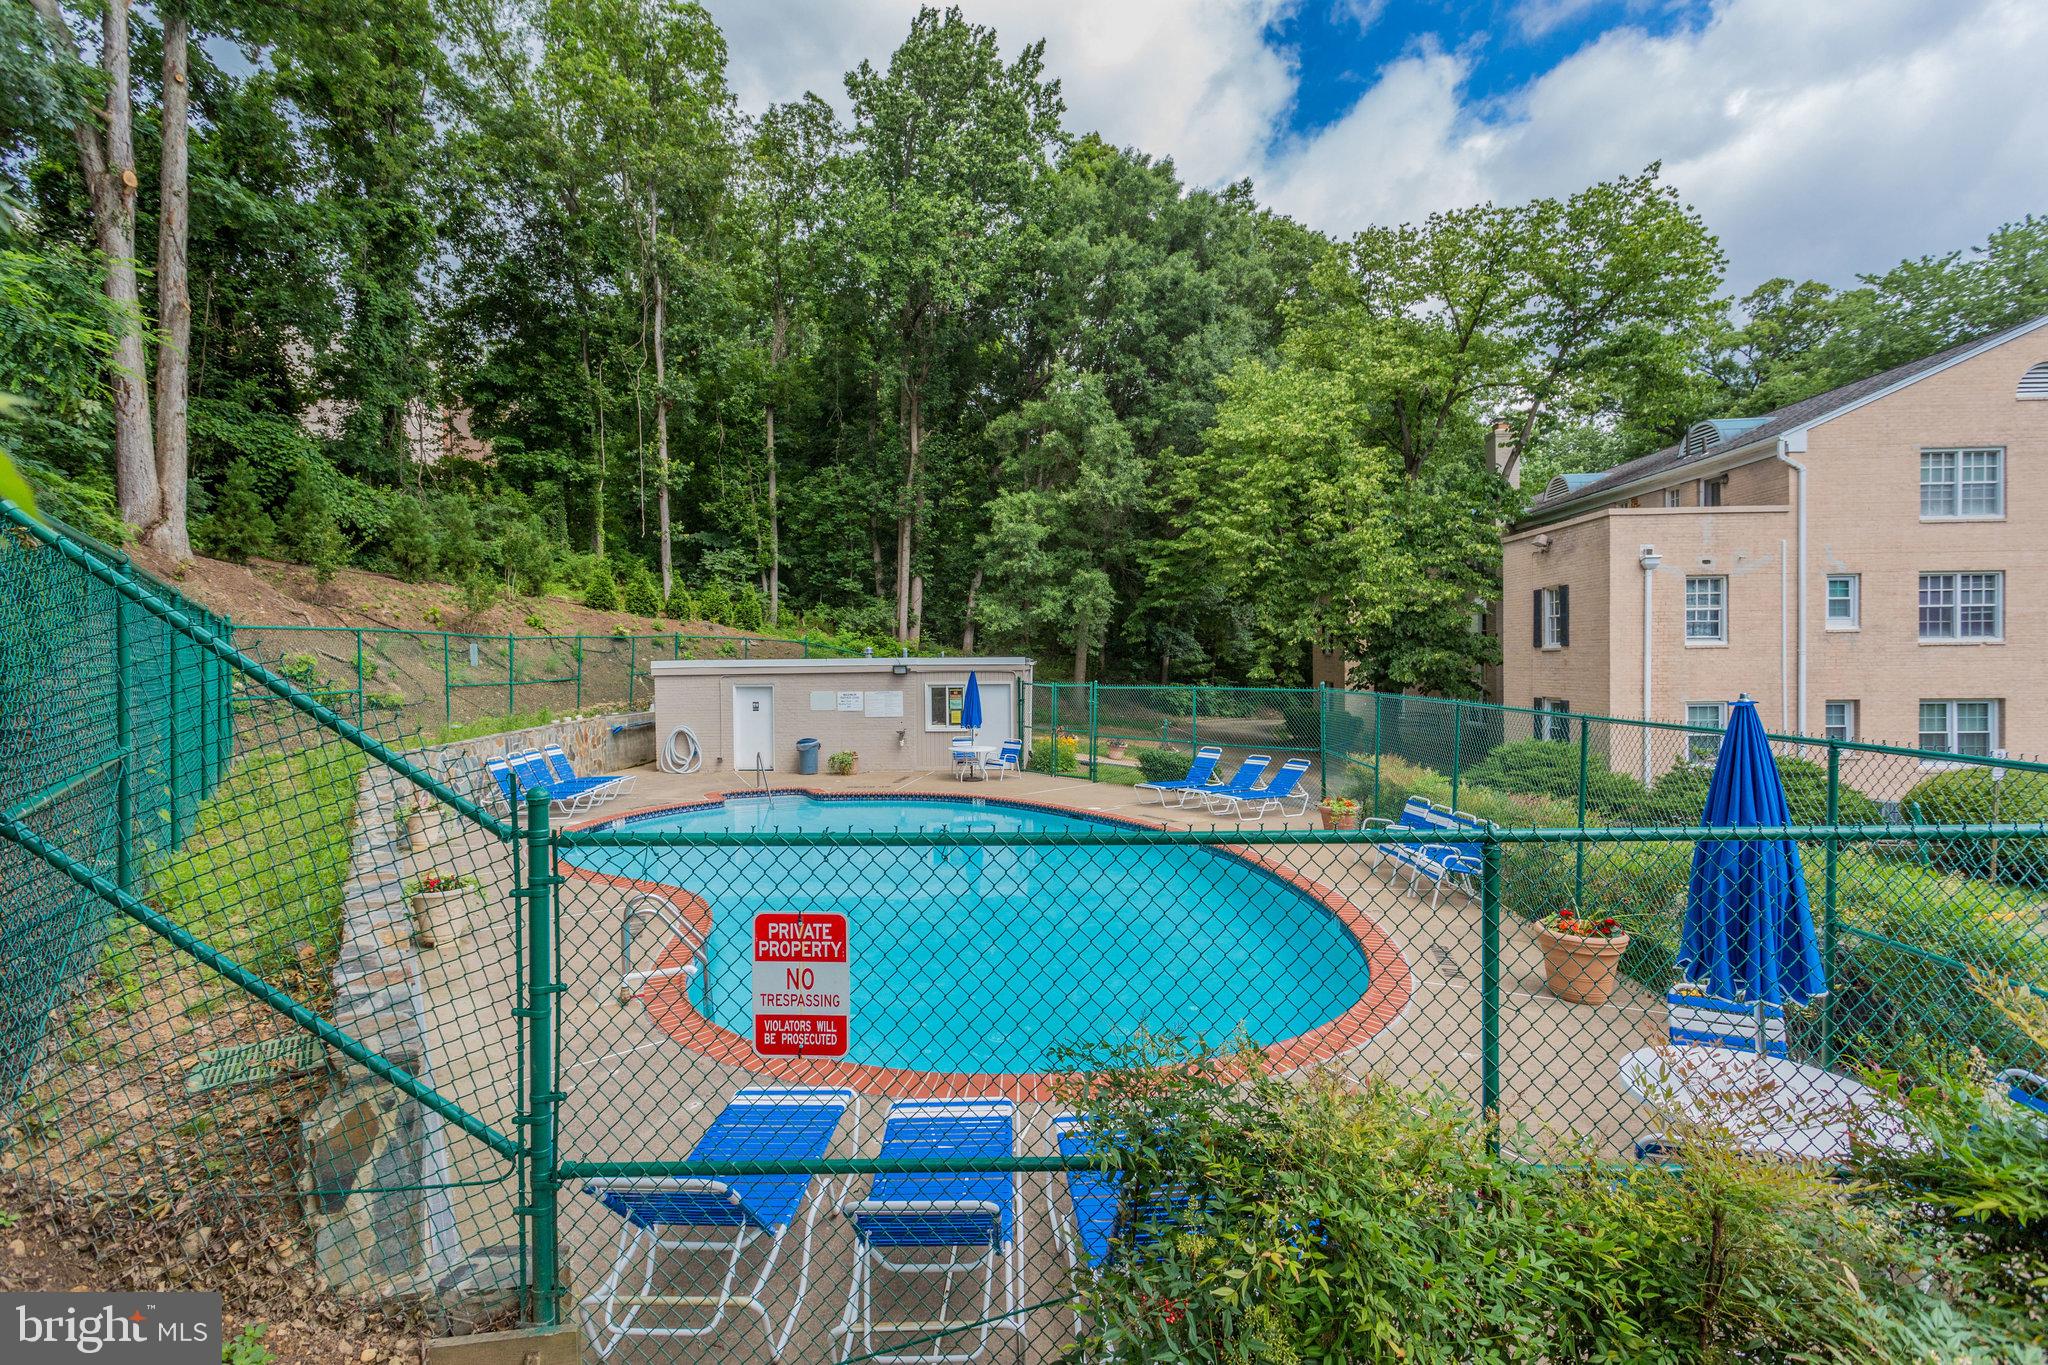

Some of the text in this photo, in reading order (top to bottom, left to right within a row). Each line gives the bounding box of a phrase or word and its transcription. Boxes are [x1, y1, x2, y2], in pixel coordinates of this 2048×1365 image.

[768, 923, 832, 939] PRIVATE
[758, 941, 842, 957] PROPERTY
[786, 968, 814, 990] NO
[760, 994, 840, 1007] TRESPASSING
[764, 1020, 837, 1032] VIOLATORS WILL
[764, 1033, 837, 1045] BE PROSECUTED
